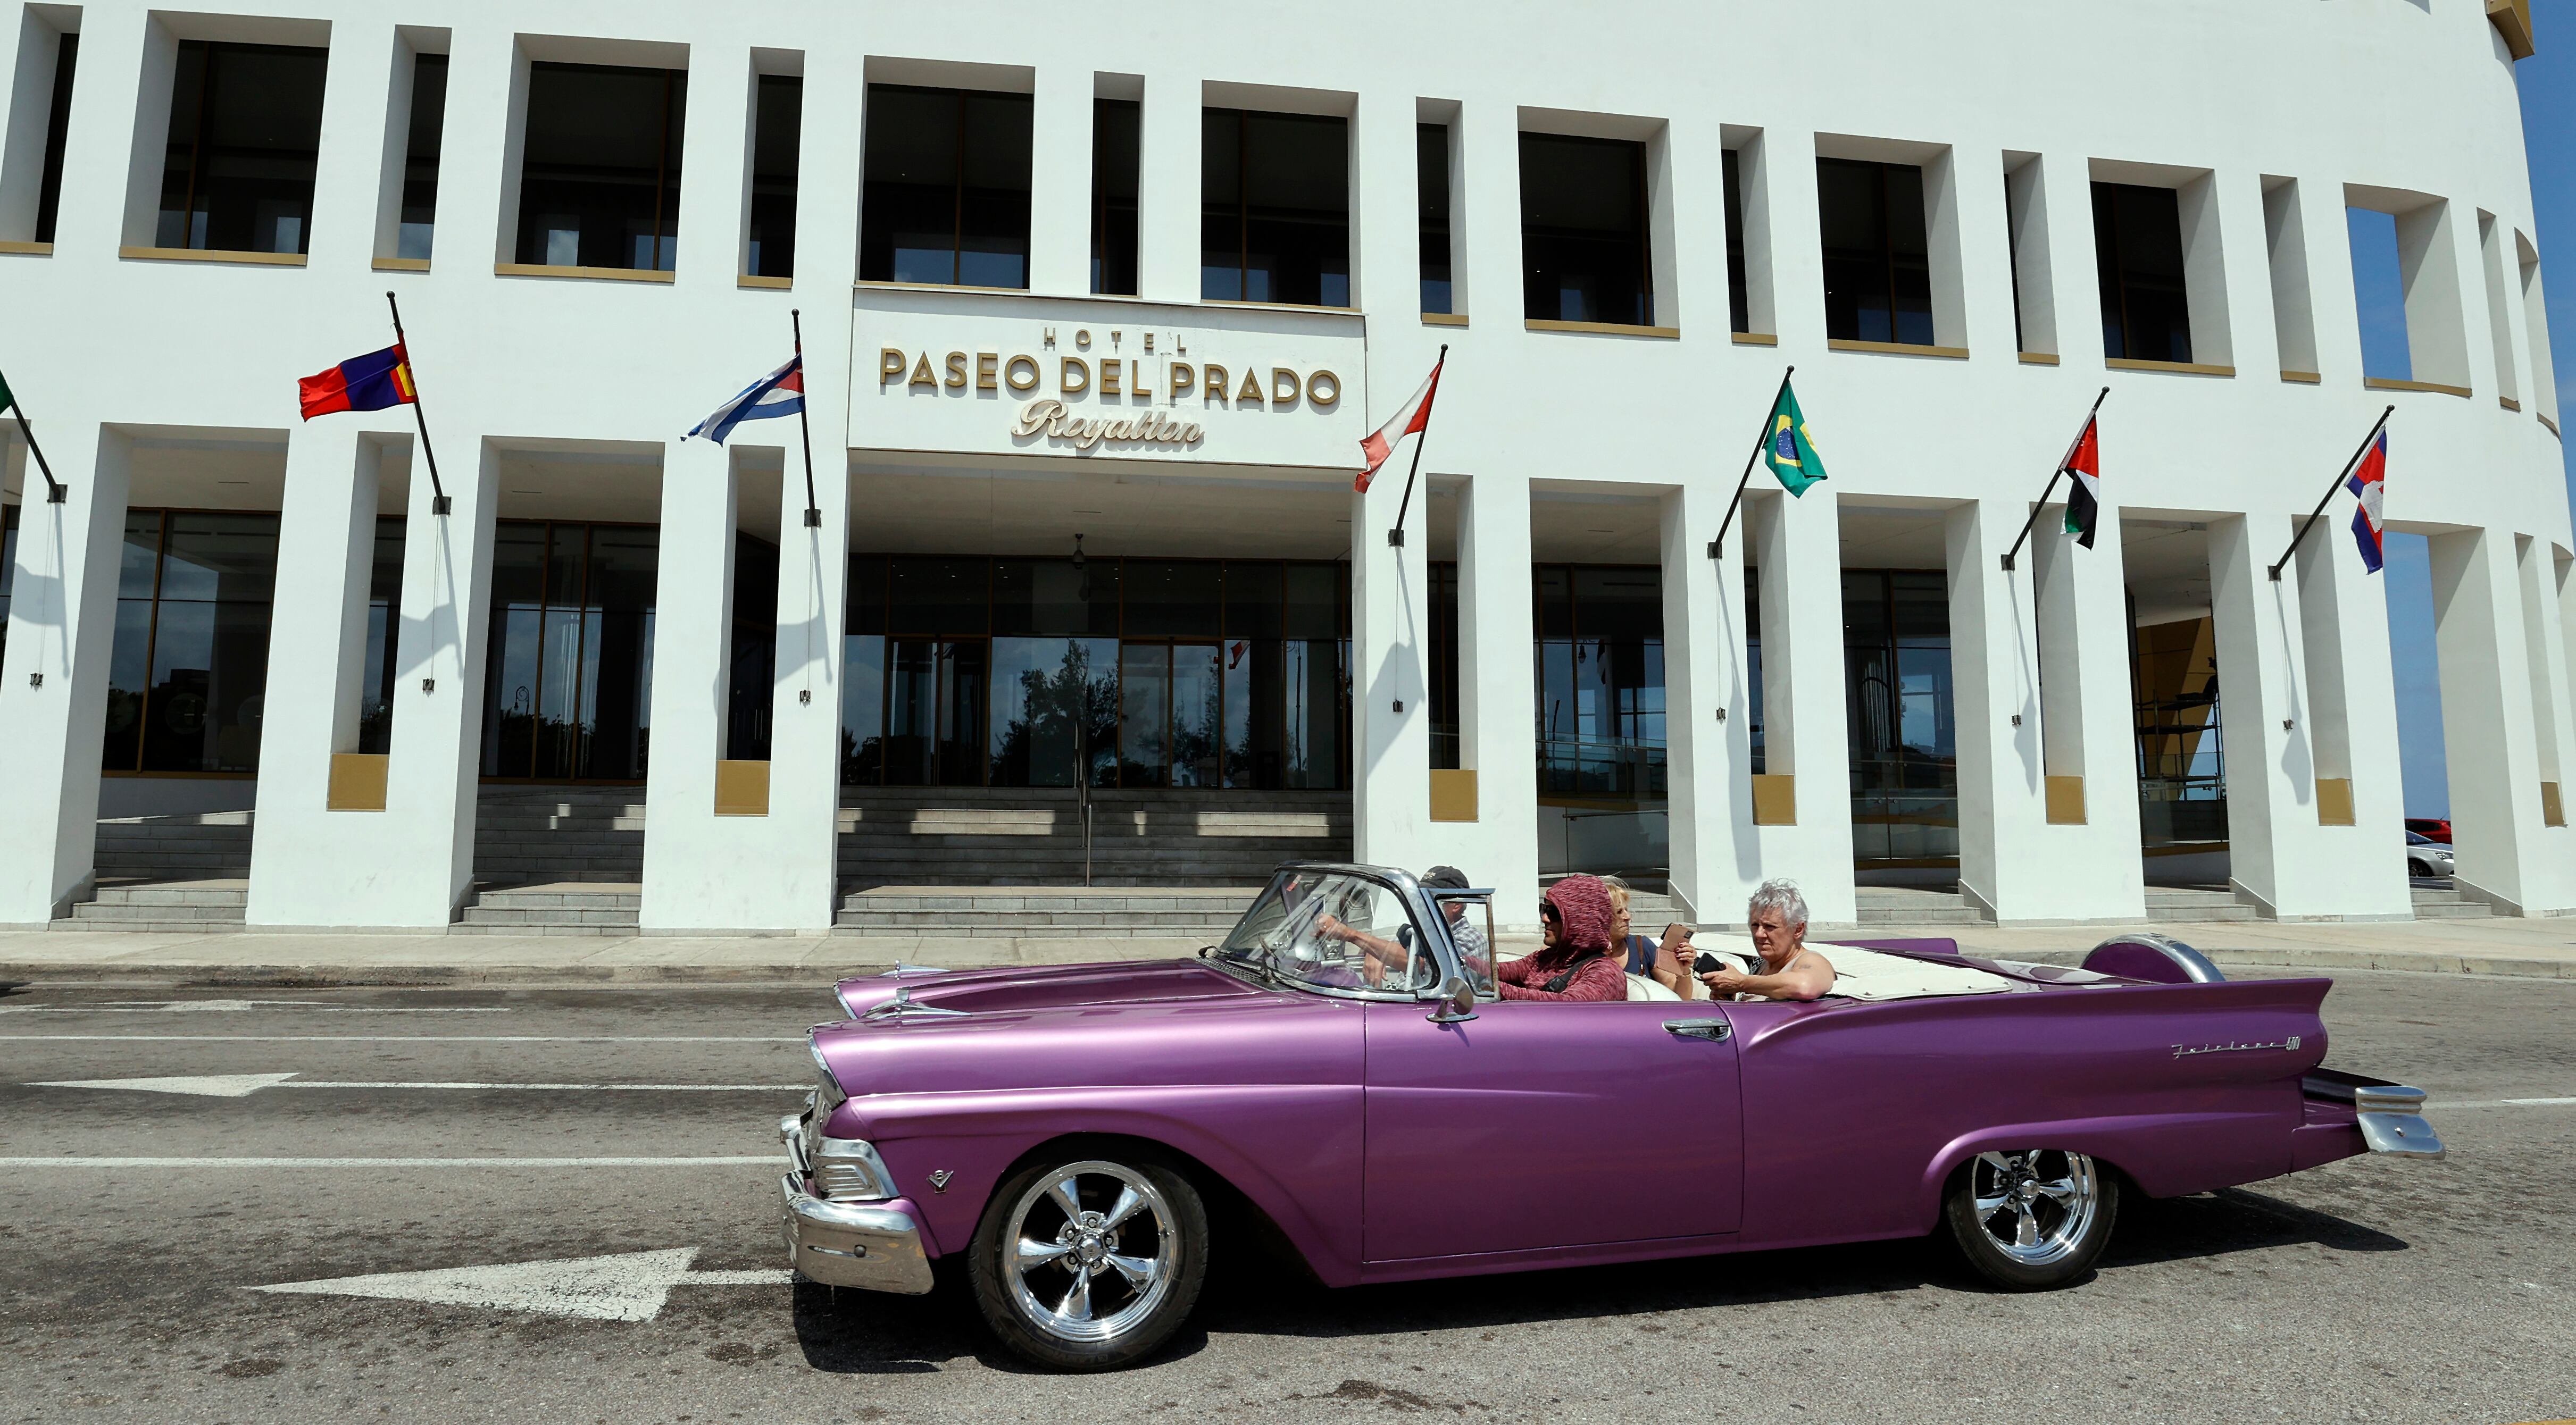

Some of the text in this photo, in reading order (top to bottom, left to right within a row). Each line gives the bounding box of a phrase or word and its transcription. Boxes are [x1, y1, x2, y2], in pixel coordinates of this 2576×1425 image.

[1044, 327, 1187, 351] HOTEL
[879, 347, 1341, 405] PASEO DEL PRADO
[1011, 399, 1205, 449] Royalton
